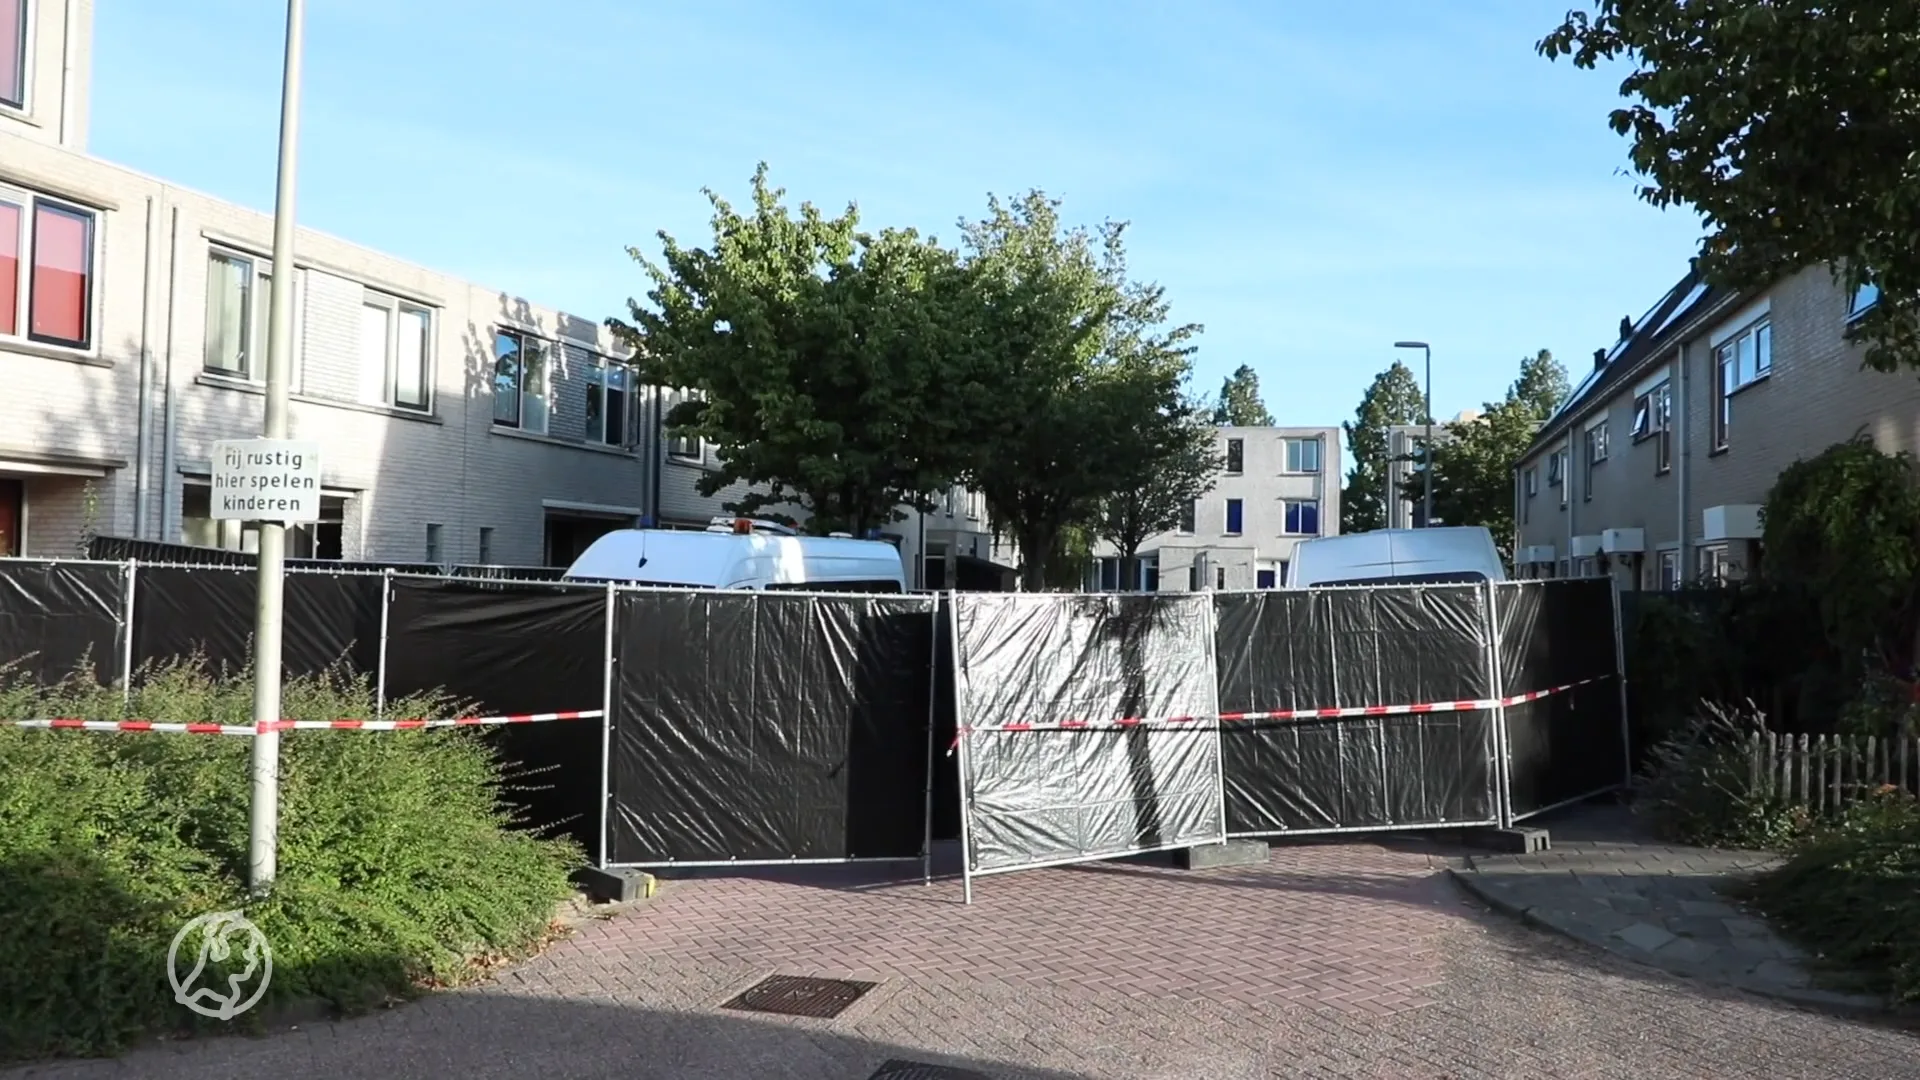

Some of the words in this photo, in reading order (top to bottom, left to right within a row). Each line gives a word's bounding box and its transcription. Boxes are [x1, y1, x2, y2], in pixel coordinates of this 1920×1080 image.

[225, 450, 242, 470] rij
[247, 450, 302, 470] rustig
[215, 473, 246, 488] hier
[250, 473, 314, 491] spelen
[223, 494, 300, 511] kinderen
